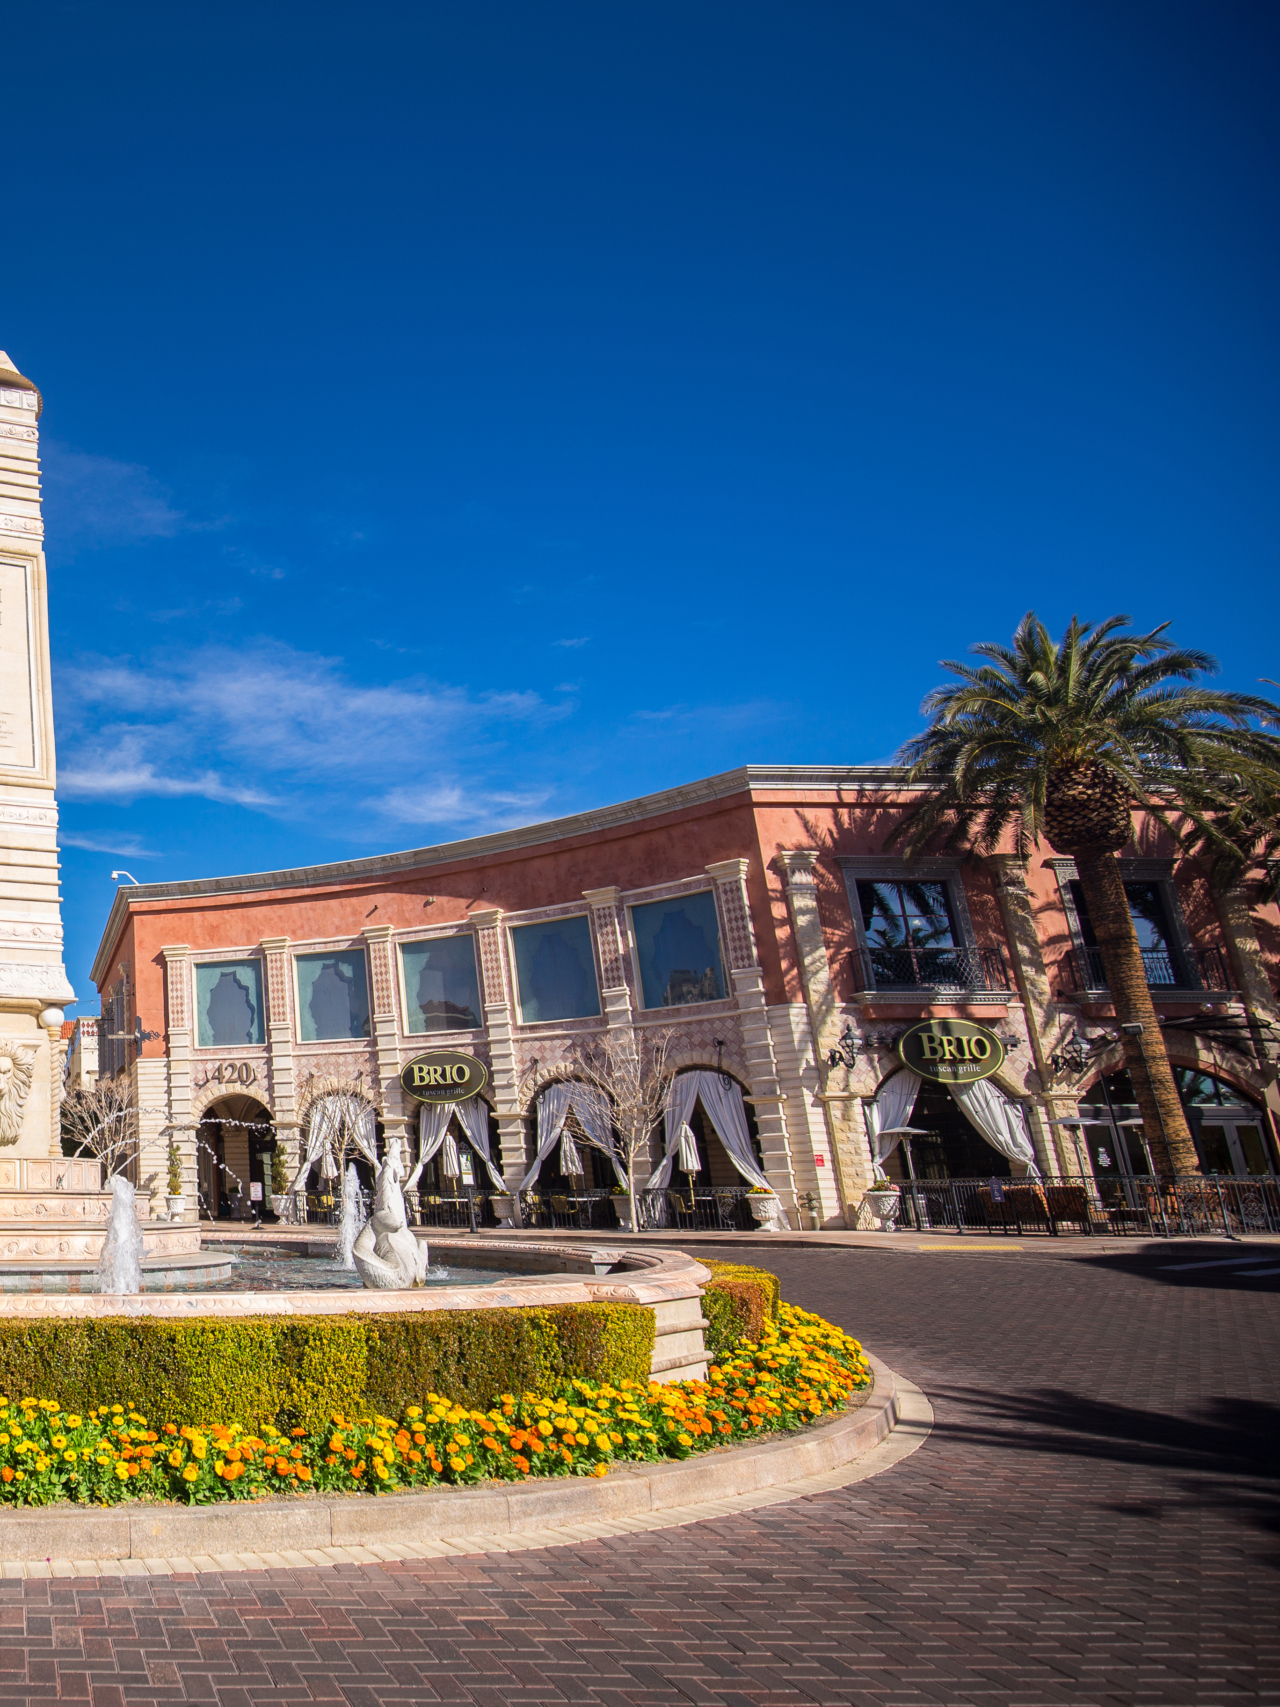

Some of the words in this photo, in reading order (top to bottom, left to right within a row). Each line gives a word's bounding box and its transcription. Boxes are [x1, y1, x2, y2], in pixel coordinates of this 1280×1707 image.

[918, 1033, 991, 1059] BRIO
[211, 1062, 252, 1084] 420
[411, 1064, 470, 1086] BRIO
[958, 1064, 981, 1074] grille
[446, 1087, 465, 1096] grille
